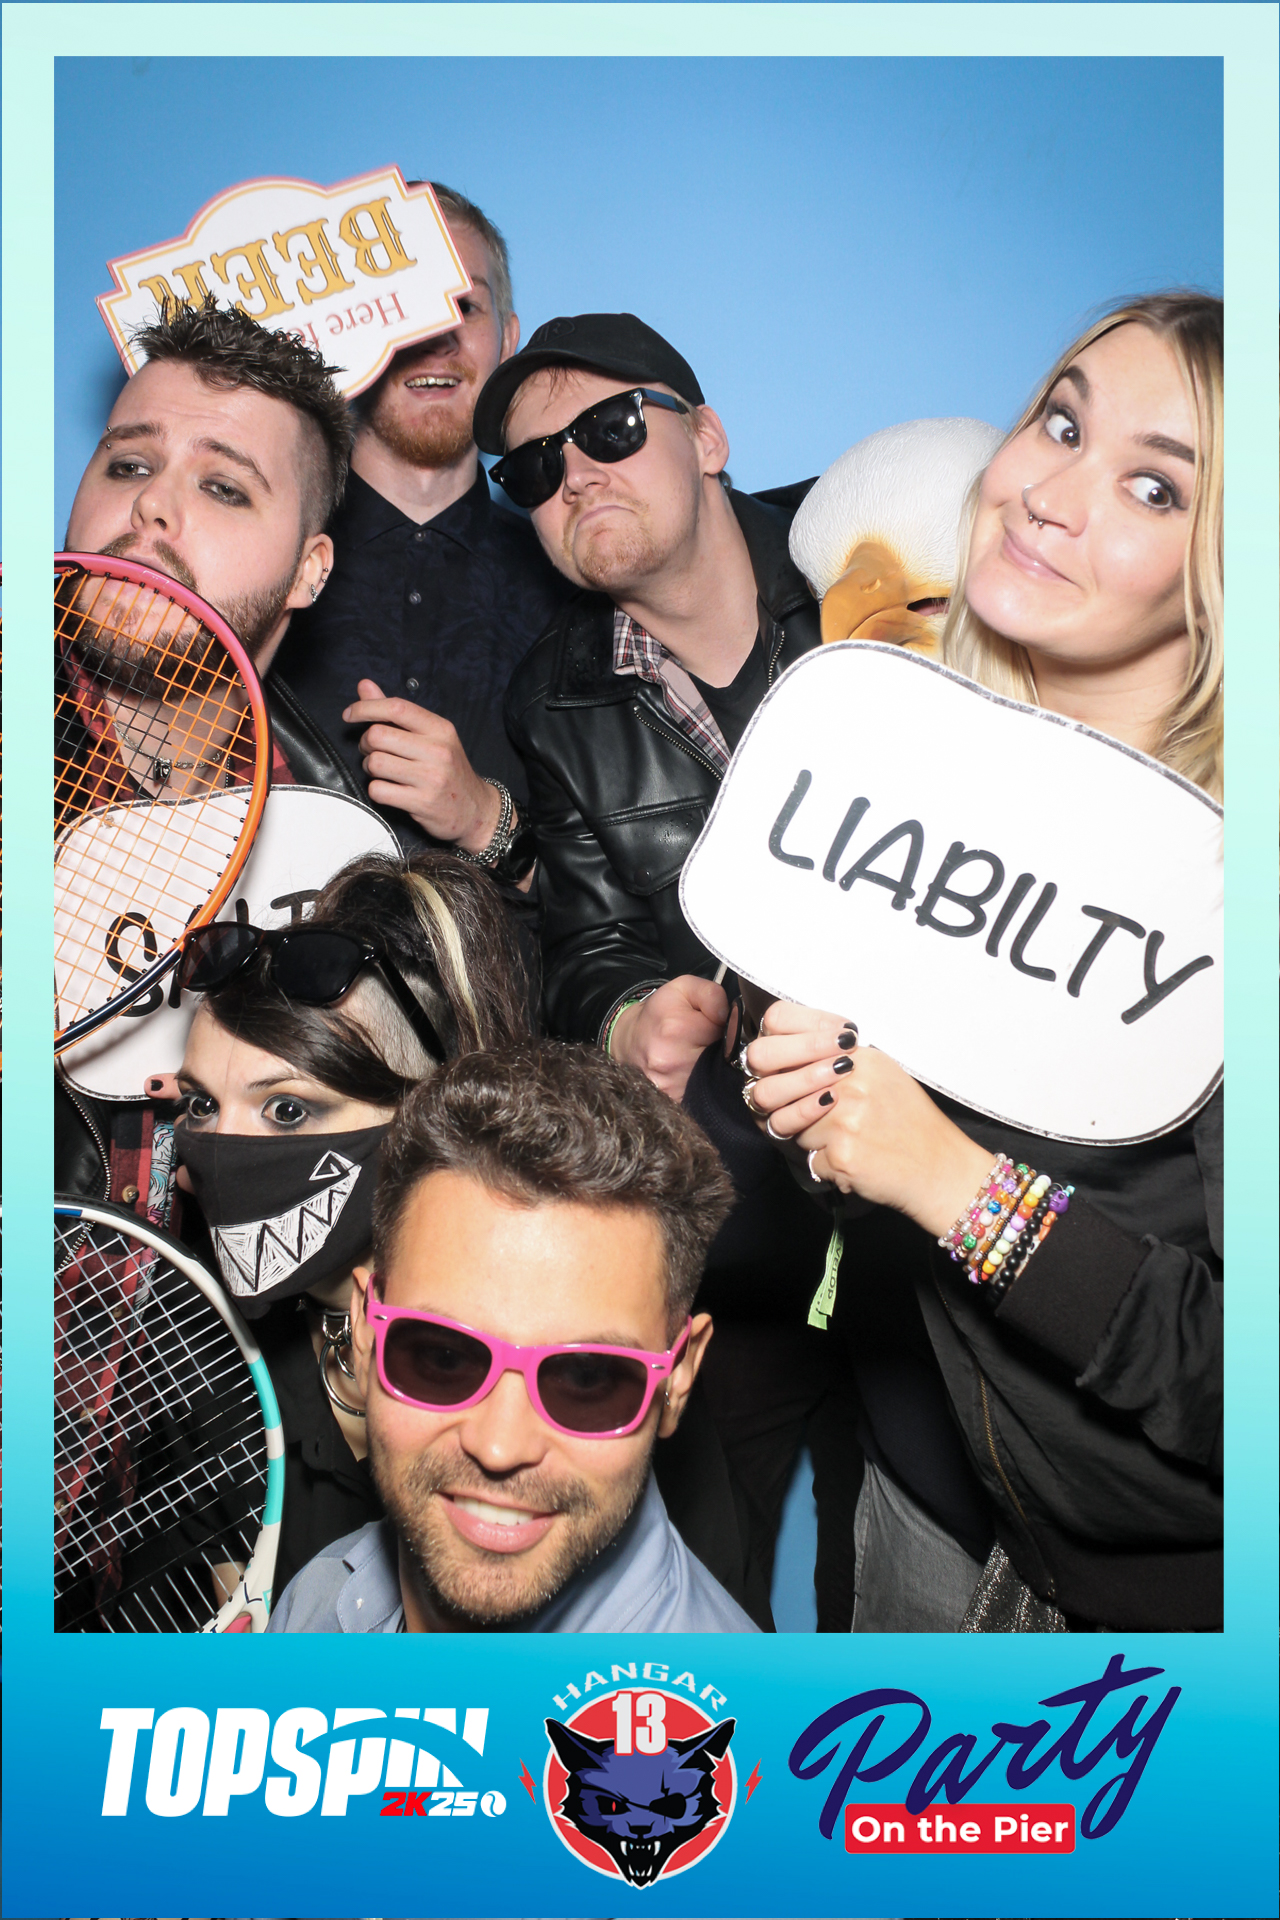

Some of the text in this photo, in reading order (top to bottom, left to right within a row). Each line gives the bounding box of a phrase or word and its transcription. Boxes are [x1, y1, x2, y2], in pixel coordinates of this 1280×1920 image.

[280, 291, 409, 350] Here fo
[767, 768, 1215, 1025] LIABILTY
